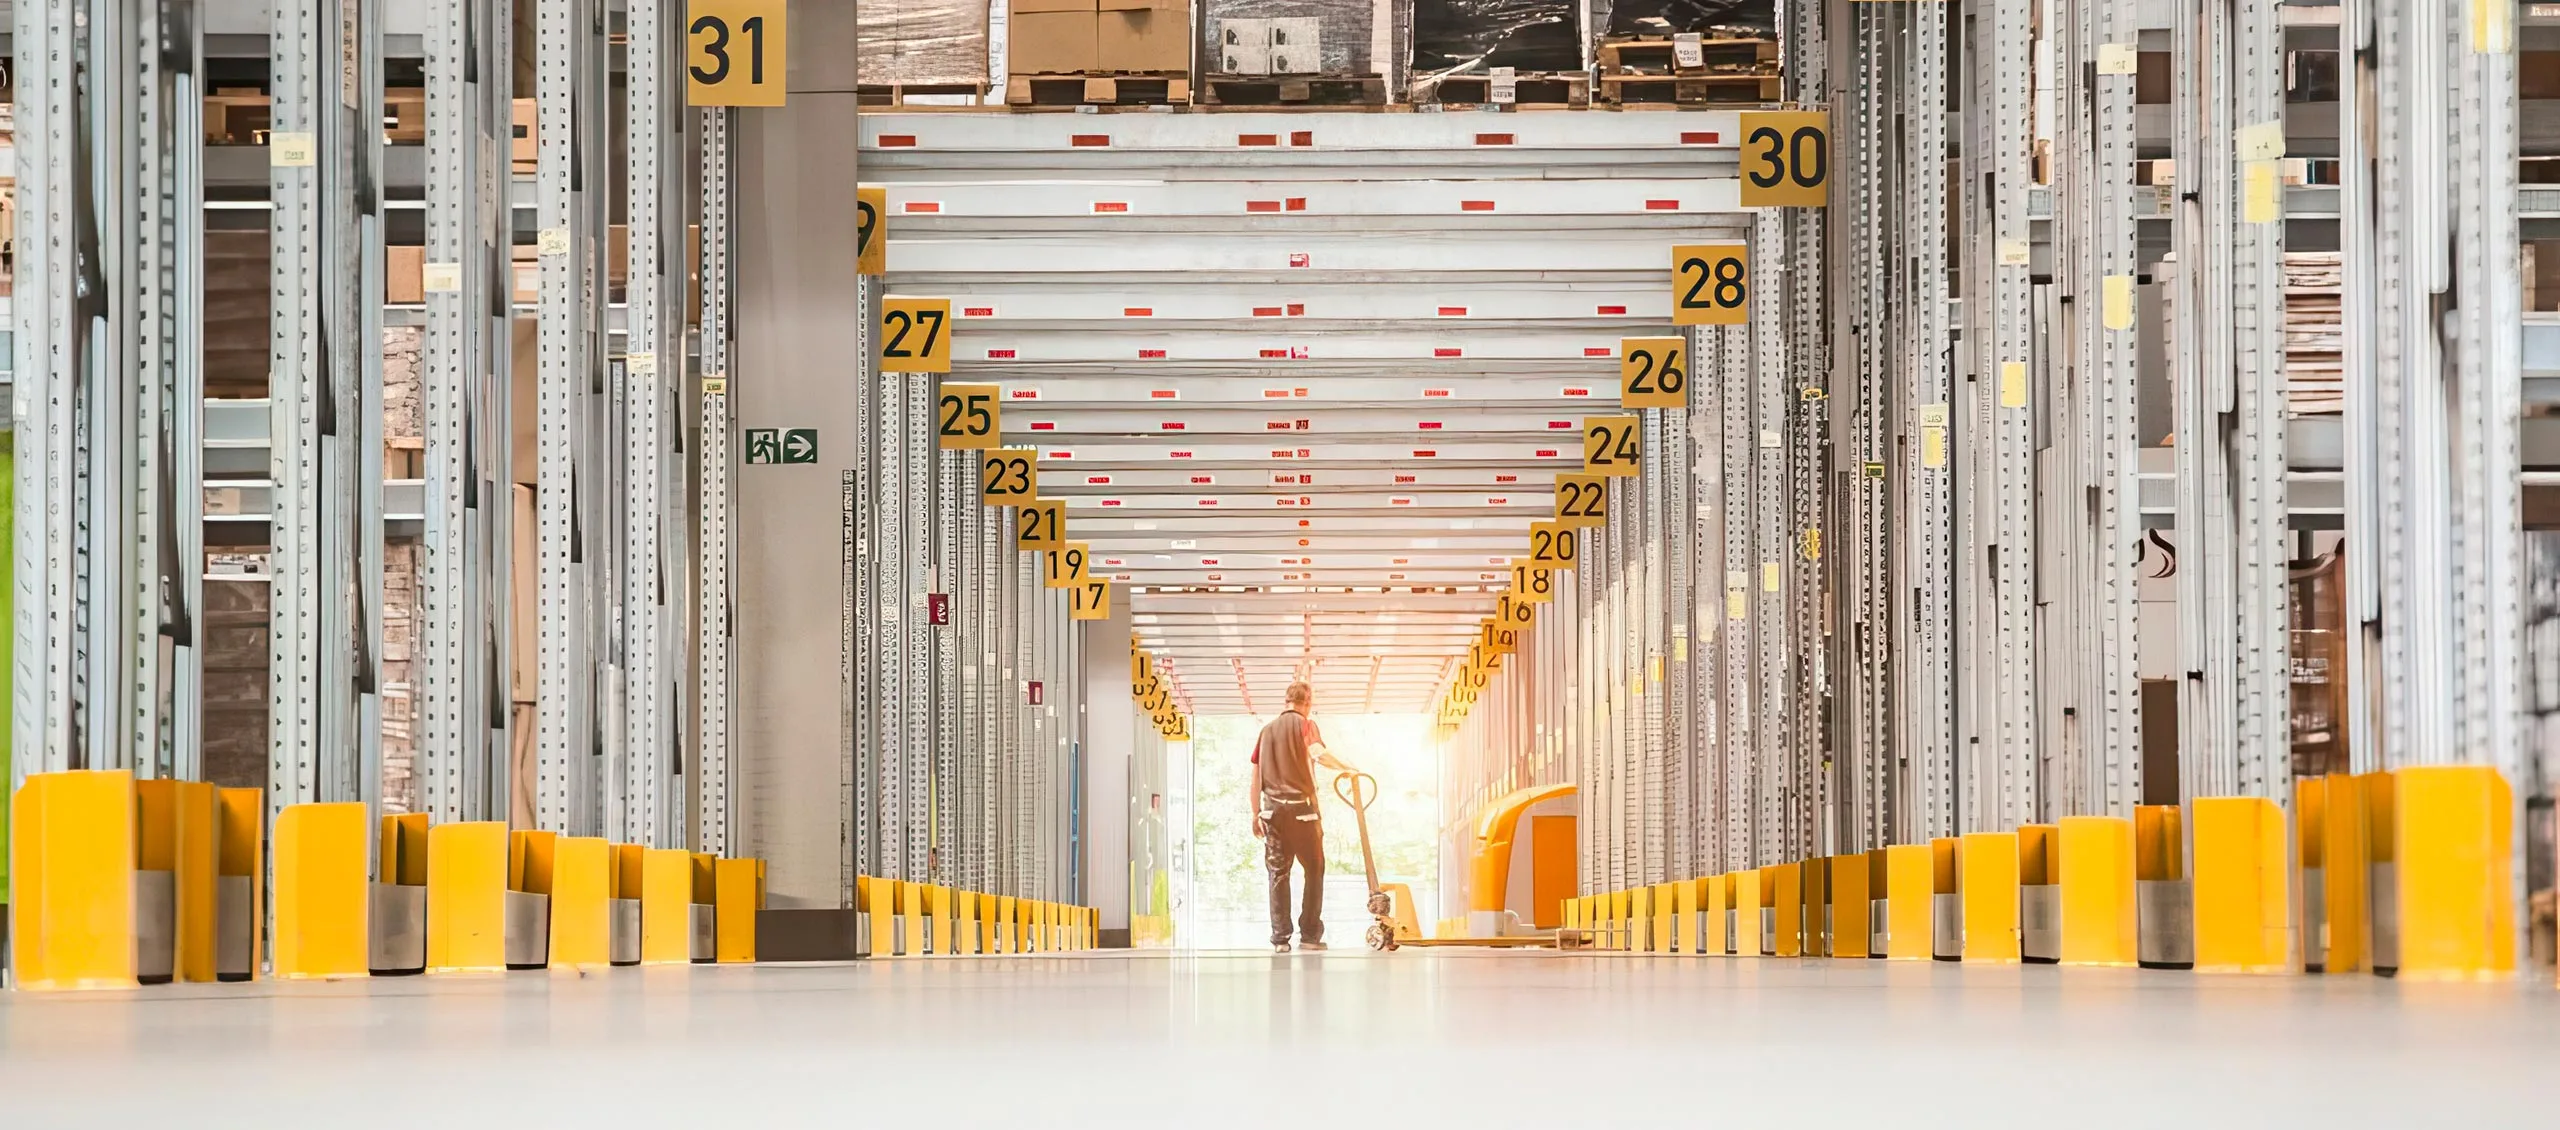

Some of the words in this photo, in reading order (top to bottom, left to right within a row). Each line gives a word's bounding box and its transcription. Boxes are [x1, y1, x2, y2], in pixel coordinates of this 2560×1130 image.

[689, 15, 763, 85] 31
[1748, 126, 1827, 189] 30
[858, 200, 876, 258] 9
[1680, 257, 1746, 309] 28
[883, 310, 944, 358] 27
[1628, 349, 1684, 394] 26
[940, 394, 991, 436] 25
[1589, 425, 1640, 465] 24
[984, 457, 1030, 495] 23
[1560, 482, 1604, 517] 22
[1020, 507, 1056, 541] 21
[1048, 549, 1083, 580] 19
[1535, 530, 1574, 561] 20
[1075, 583, 1105, 611] 17
[1515, 566, 1550, 594] 18
[1501, 596, 1532, 622] 16
